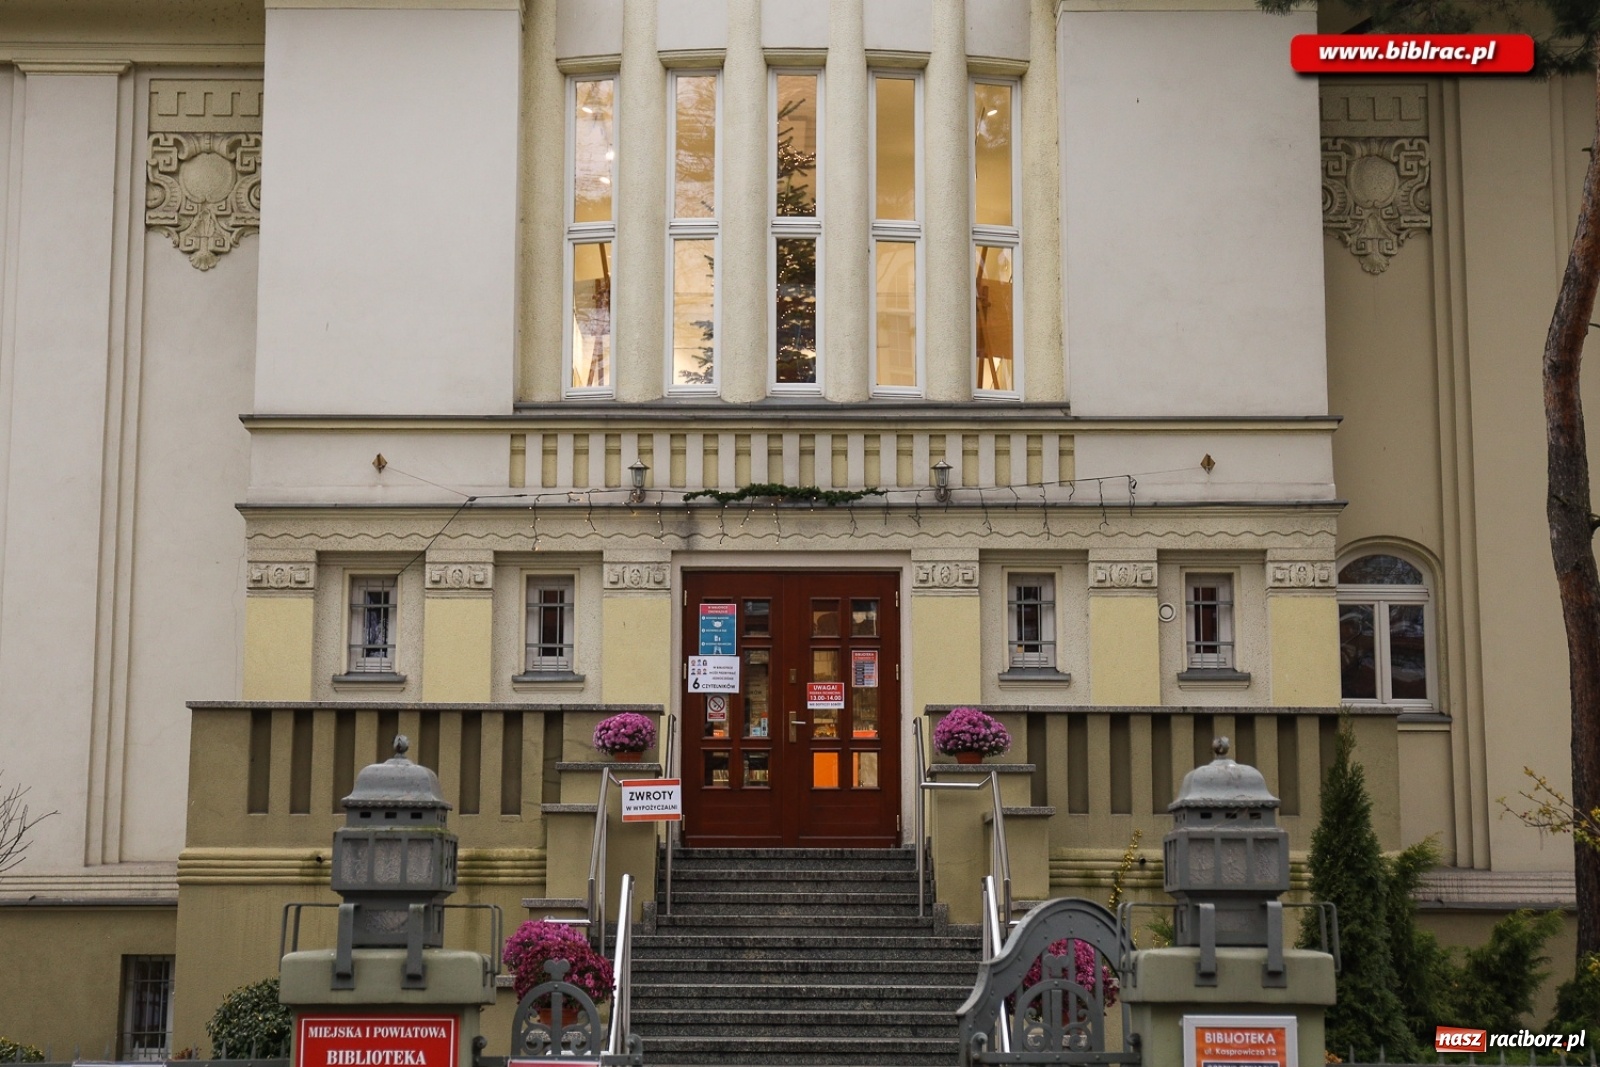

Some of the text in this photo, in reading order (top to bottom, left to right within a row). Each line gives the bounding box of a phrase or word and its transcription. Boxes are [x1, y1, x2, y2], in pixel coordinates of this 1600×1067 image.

[692, 677, 700, 690] 6
[628, 790, 674, 801] ZWROTY
[308, 1026, 447, 1038] MIEJSKA I POWIATOWA
[1204, 1032, 1276, 1044] BIBLIOTEKA
[326, 1050, 427, 1066] BIBLIOTEKA
[1215, 1048, 1265, 1057] Kasprowicza
[1267, 1048, 1277, 1056] 12
